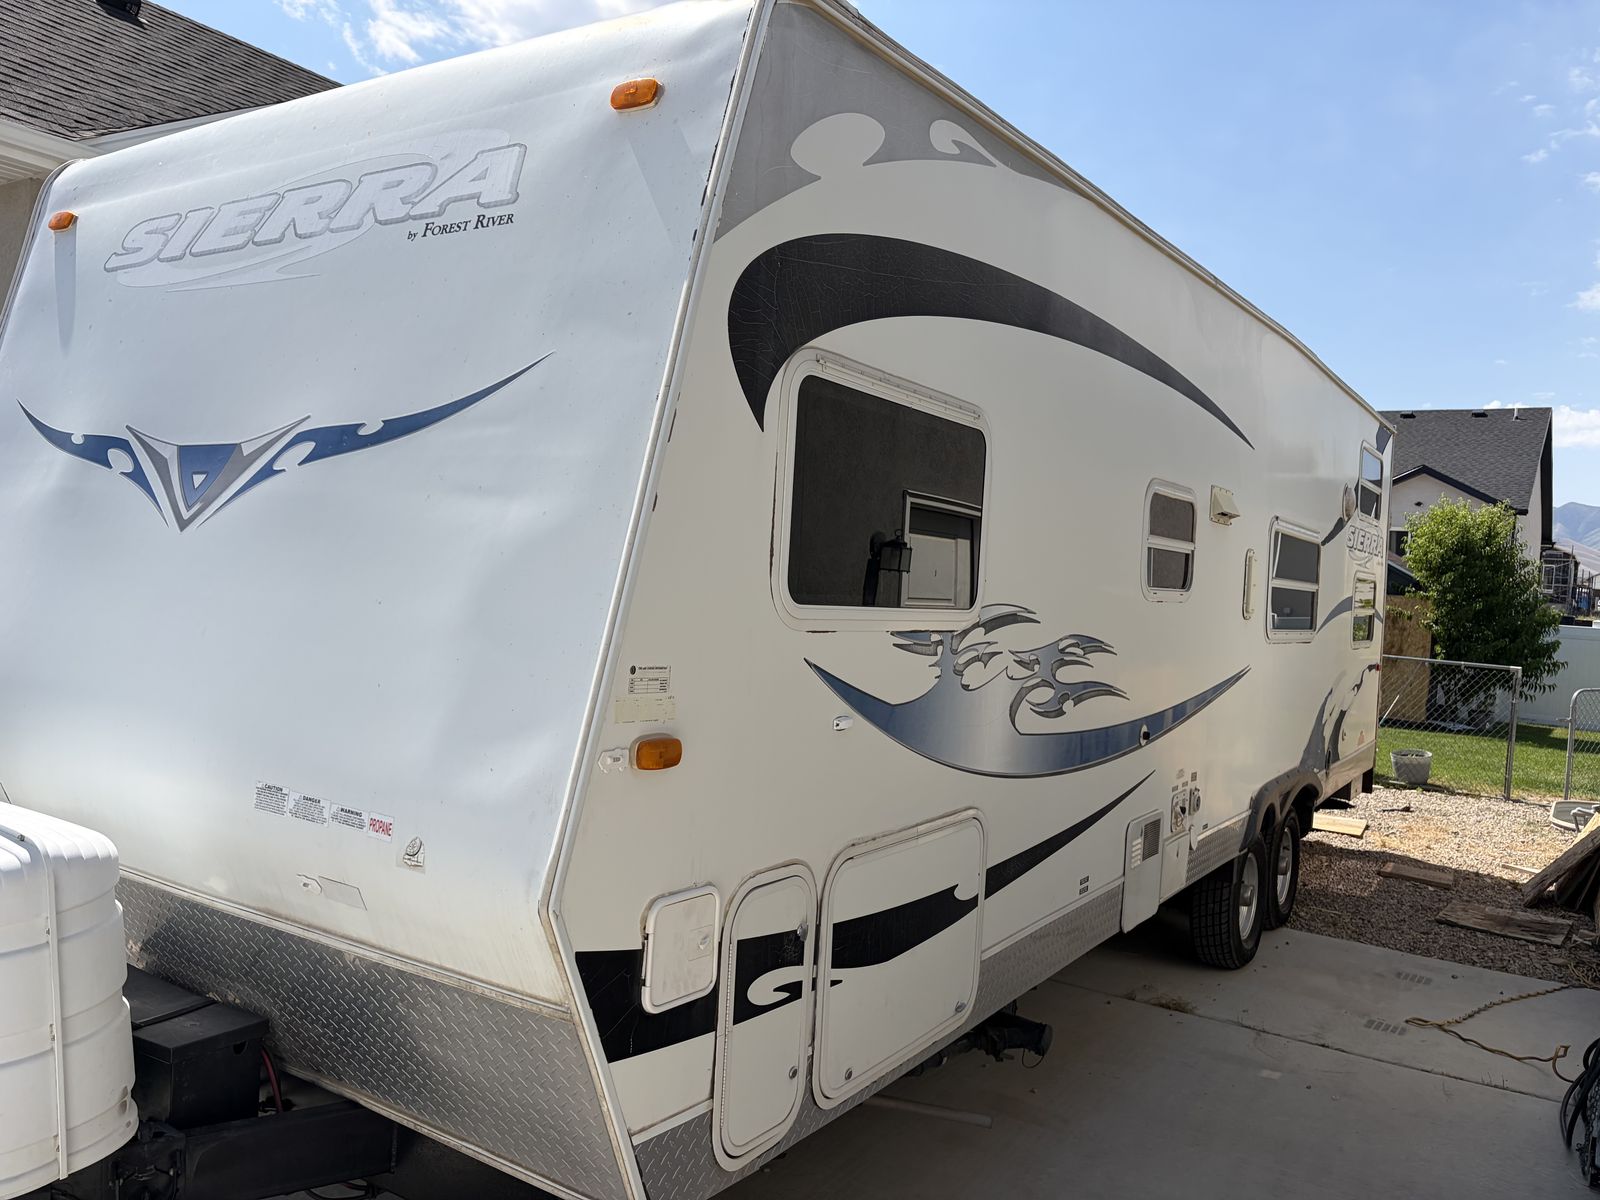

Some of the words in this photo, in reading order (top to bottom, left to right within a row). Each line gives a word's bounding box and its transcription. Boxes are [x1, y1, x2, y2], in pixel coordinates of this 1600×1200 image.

[104, 143, 528, 272] SIERRA
[407, 230, 418, 241] by
[1346, 524, 1384, 558] SIERRA
[264, 783, 283, 793] CAUTION
[302, 795, 321, 804] DANGER
[340, 807, 363, 818] WARNING
[369, 817, 392, 837] PROPANE
